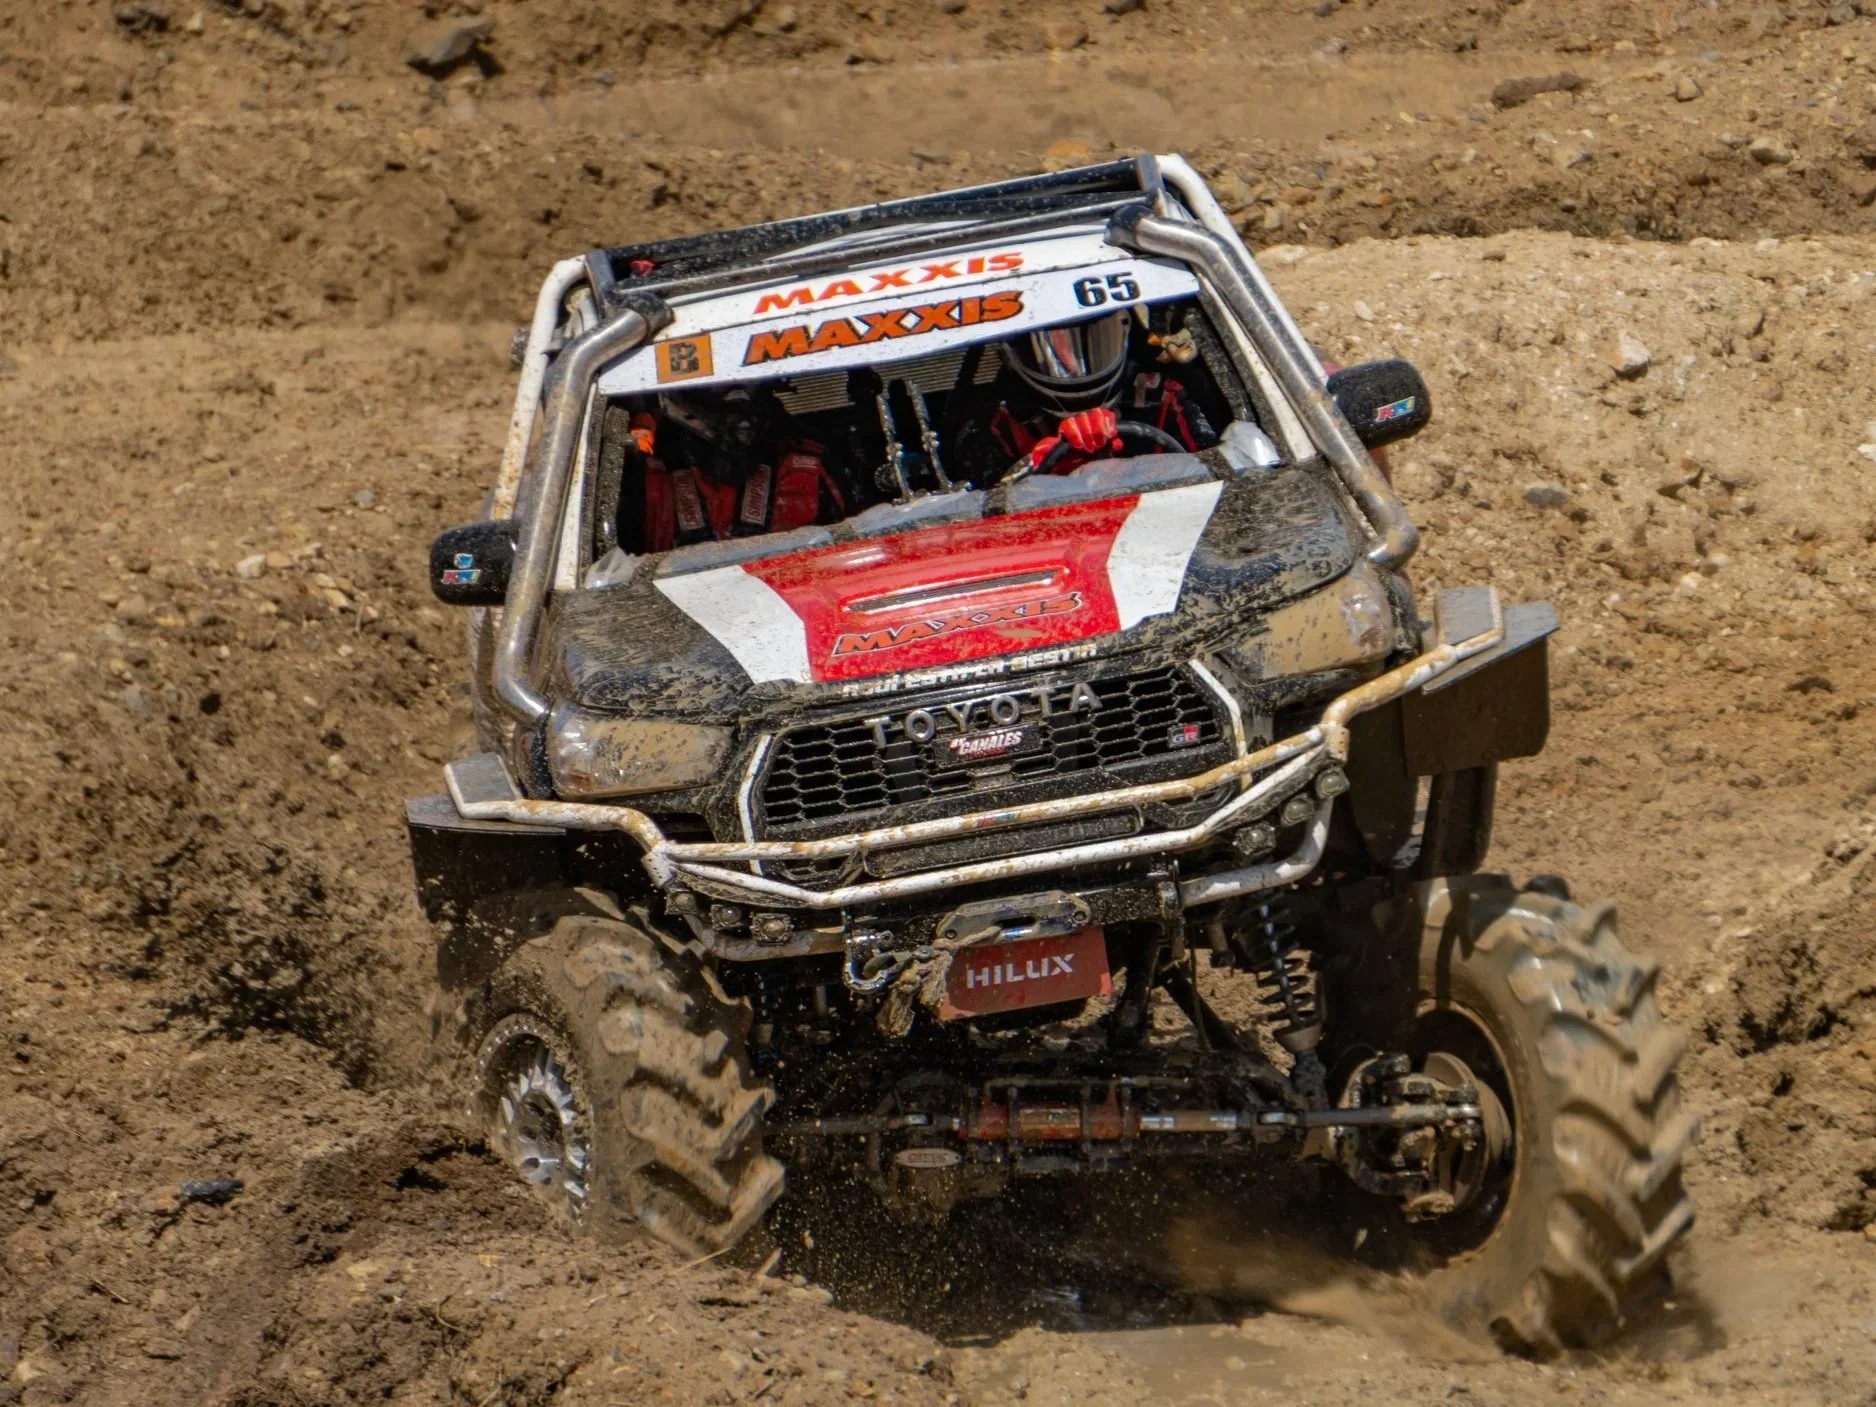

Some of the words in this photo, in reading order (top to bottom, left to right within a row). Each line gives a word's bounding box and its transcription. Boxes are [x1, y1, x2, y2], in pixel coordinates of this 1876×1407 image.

[753, 252, 1024, 315] MAXXIS
[1072, 270, 1142, 308] 65
[742, 290, 1025, 366] MAXXIS
[831, 591, 1082, 656] MAXXIS
[863, 681, 1103, 749] TOYOTA
[957, 731, 1023, 756] CANALES
[966, 953, 1075, 989] HILUX
